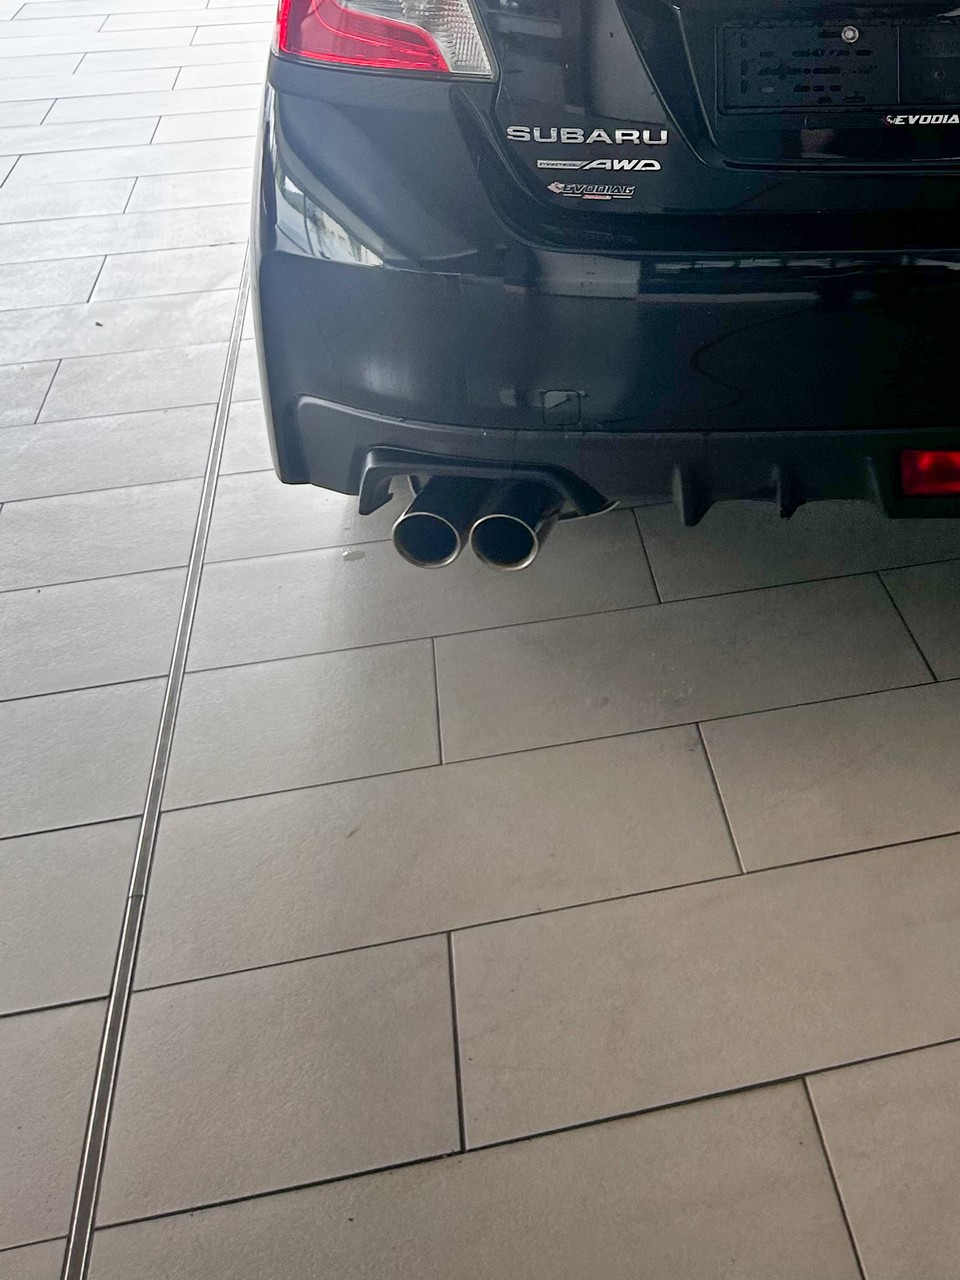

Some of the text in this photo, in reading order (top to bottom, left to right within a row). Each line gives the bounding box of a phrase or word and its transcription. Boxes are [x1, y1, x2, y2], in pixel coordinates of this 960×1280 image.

[506, 125, 669, 145] SUBARU
[582, 159, 662, 171] AWD
[562, 183, 636, 196] EVODIAG
